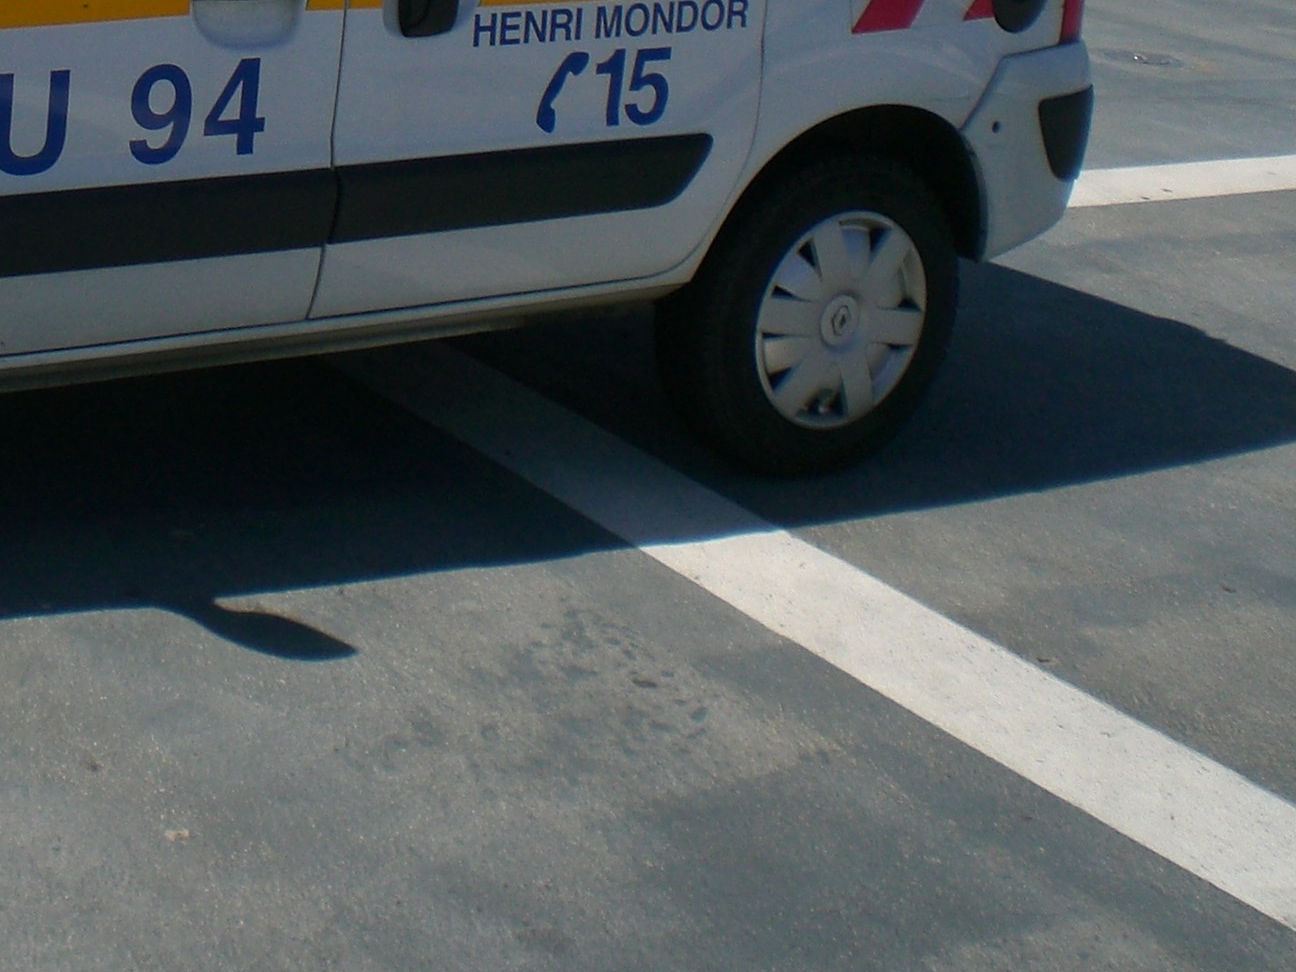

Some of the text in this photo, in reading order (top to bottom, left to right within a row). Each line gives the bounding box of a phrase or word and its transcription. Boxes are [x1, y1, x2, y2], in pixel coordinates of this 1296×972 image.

[472, 7, 584, 48] HENRI
[128, 57, 266, 166] 94
[595, 46, 673, 127] 15
